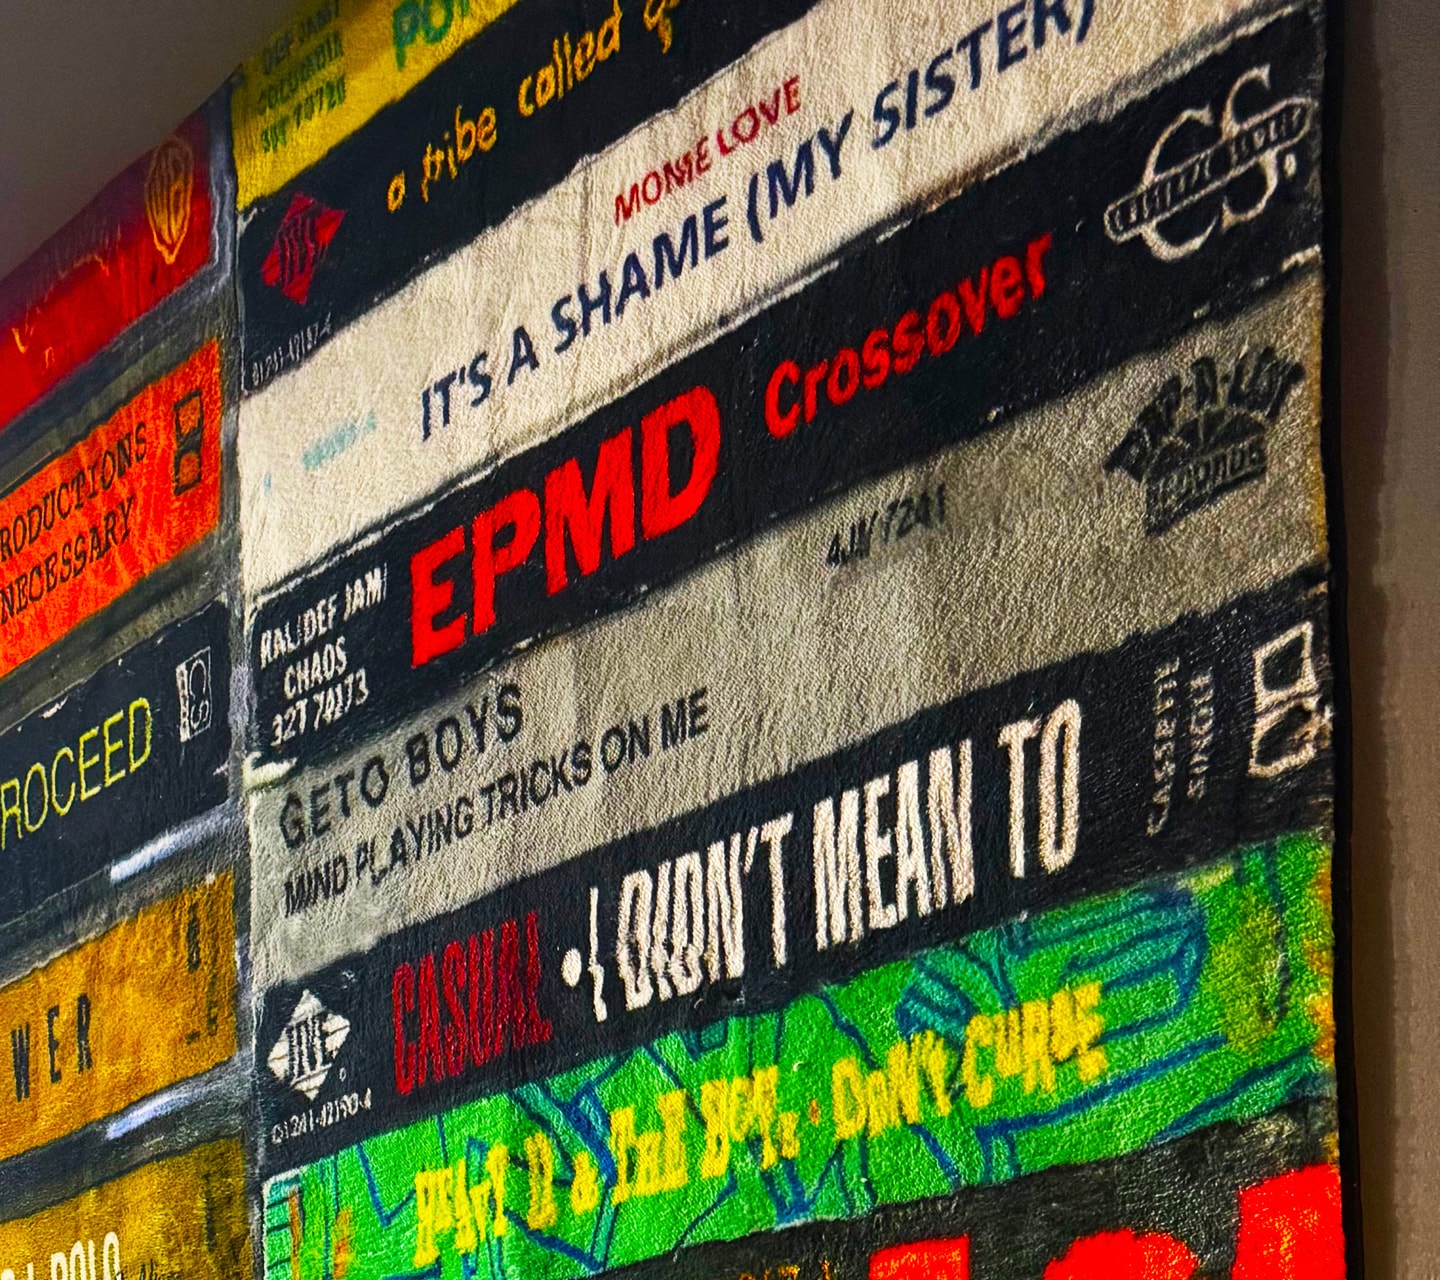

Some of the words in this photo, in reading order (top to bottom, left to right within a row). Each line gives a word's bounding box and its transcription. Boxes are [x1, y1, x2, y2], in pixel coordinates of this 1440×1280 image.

[422, 104, 498, 203] tribe
[519, 0, 623, 117] called
[717, 75, 800, 156] LOVE
[421, 353, 492, 443] IT'S
[507, 326, 540, 385] A
[550, 197, 729, 354] SHAME
[746, 111, 854, 243] (MY
[411, 384, 721, 668] EPMD
[765, 233, 1052, 440] Crossover
[0, 498, 136, 625] NECESSARY
[278, 758, 390, 850] GETO
[406, 682, 524, 790] BOYS
[283, 854, 349, 917] MIND
[356, 799, 473, 888] PLAYING
[482, 741, 592, 828] TRICKS
[601, 716, 651, 774] ON
[661, 688, 710, 753] ME
[392, 910, 553, 1096] CASUAL
[617, 813, 794, 1012] DIDN'T
[813, 738, 976, 952] MEAN
[998, 699, 1083, 879] TO
